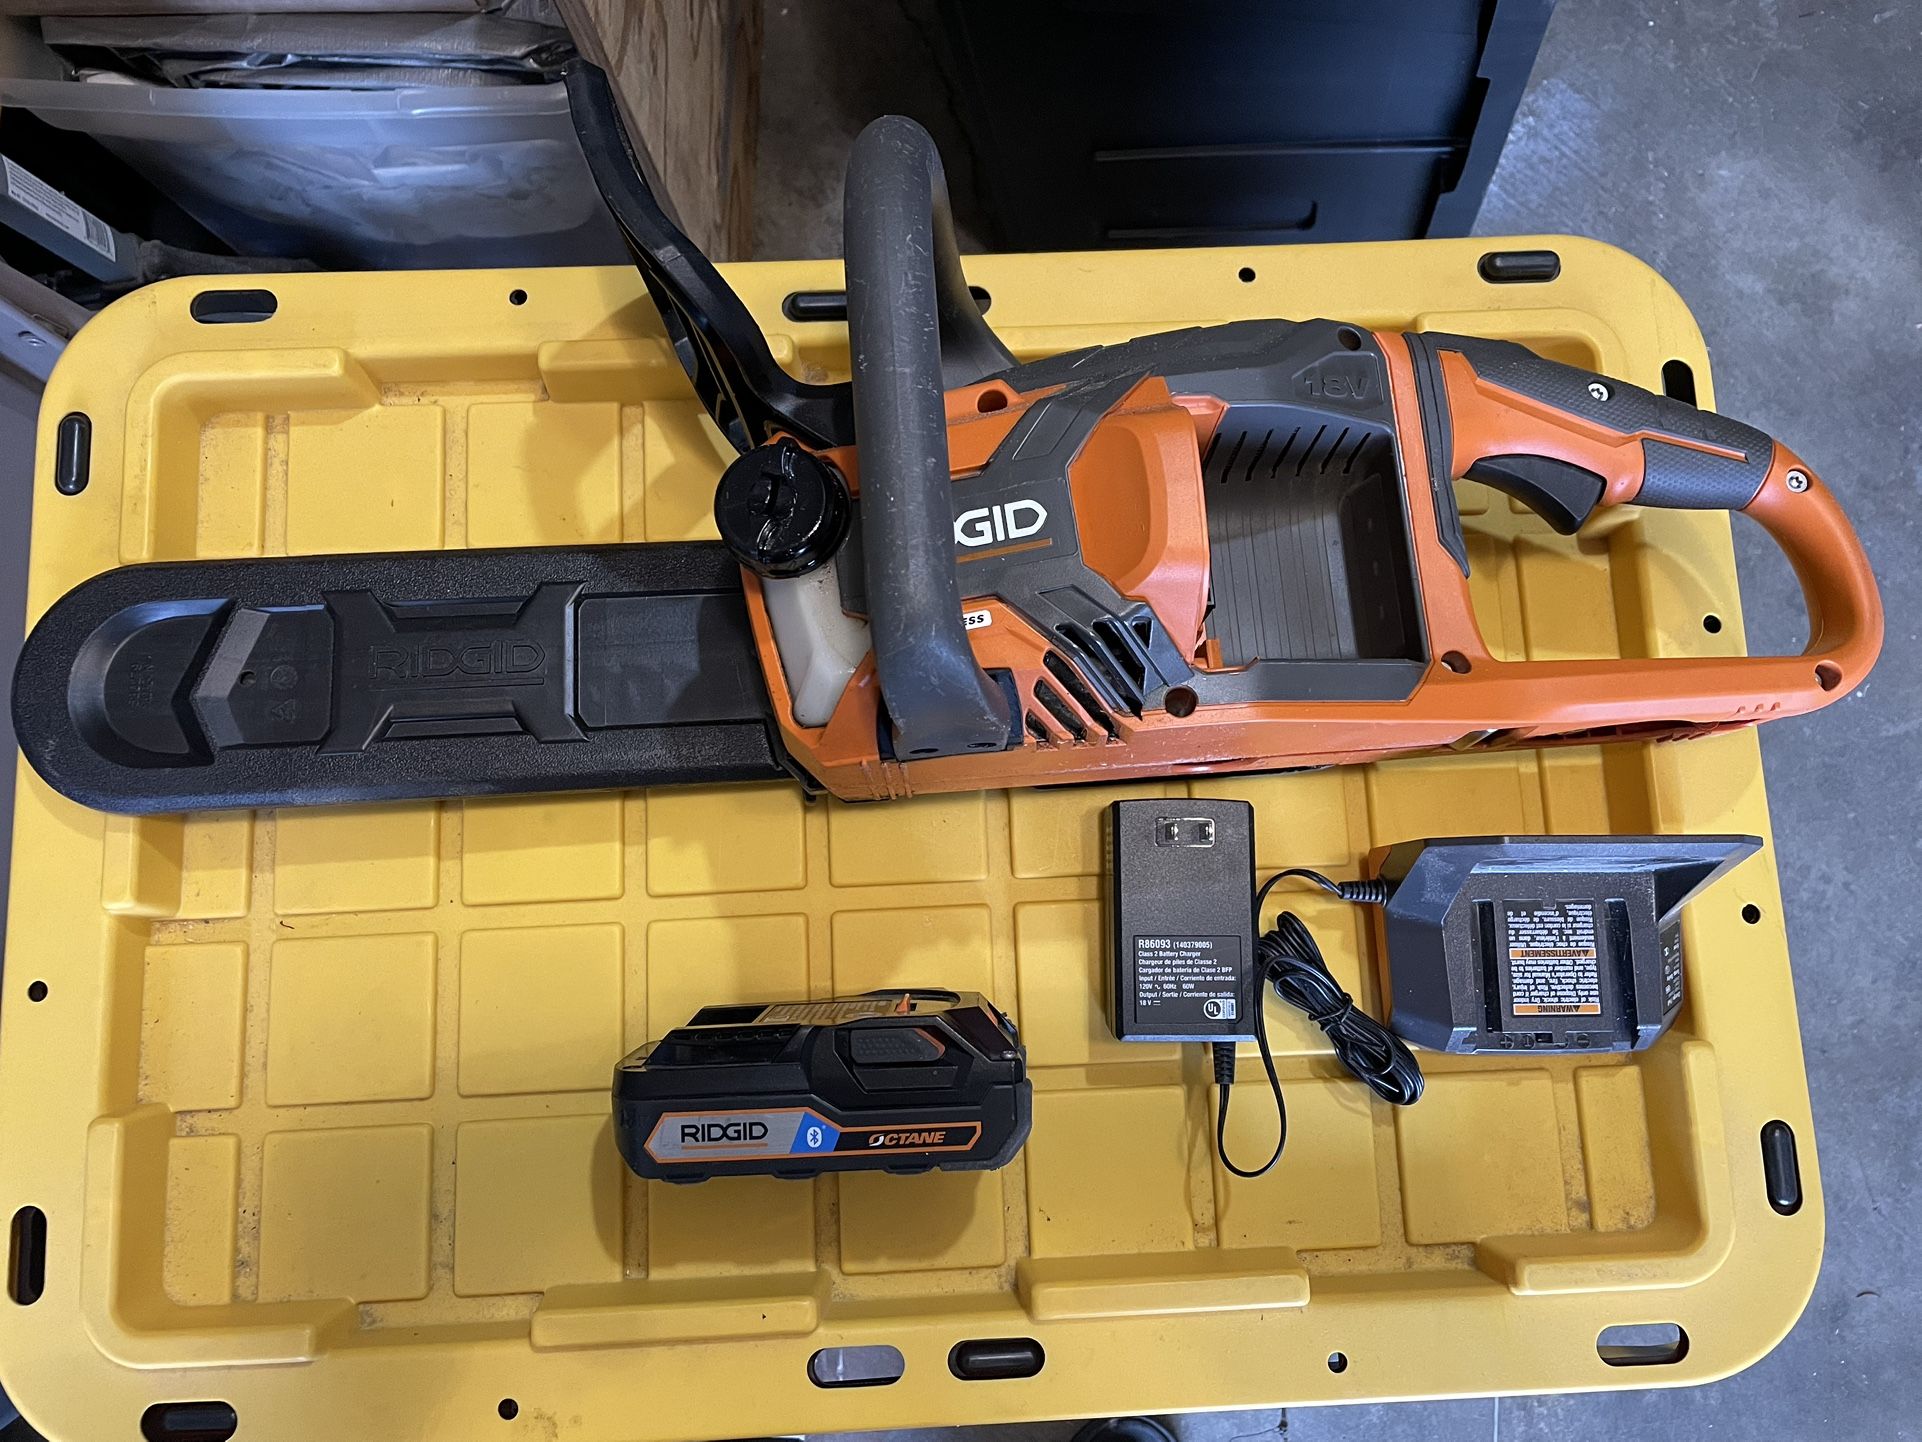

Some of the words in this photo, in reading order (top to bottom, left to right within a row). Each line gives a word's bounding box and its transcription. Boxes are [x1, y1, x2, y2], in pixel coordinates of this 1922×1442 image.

[1304, 376, 1369, 399] 18V
[953, 499, 1048, 547] GID
[963, 614, 985, 626] ESS
[369, 641, 546, 678] RIDGID
[1139, 939, 1170, 948] R86093
[681, 1121, 768, 1144] RIDGID
[868, 1131, 946, 1147] OCTANE
